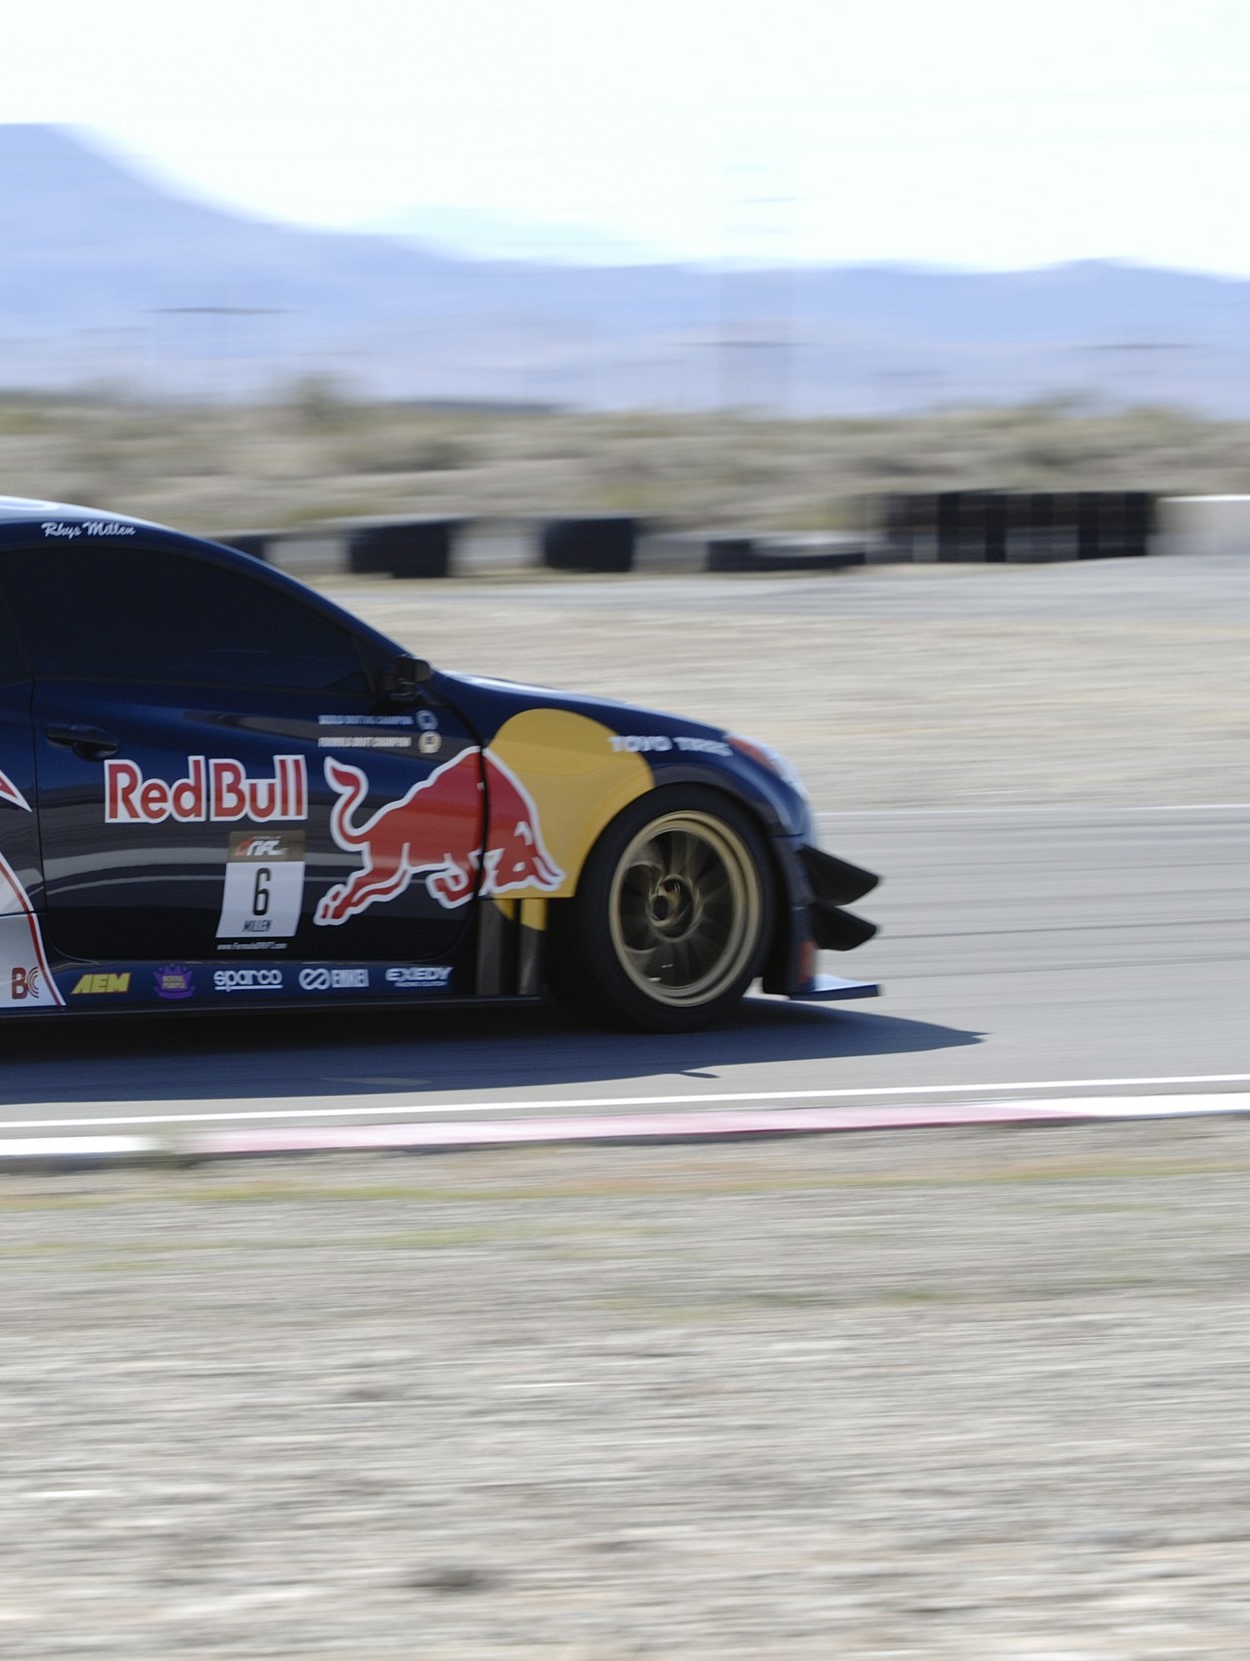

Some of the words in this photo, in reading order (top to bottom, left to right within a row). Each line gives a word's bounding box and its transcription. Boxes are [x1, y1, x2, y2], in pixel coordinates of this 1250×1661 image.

[41, 522, 82, 539] Rhys
[82, 521, 136, 536] Millen
[252, 867, 272, 916] 6
[70, 973, 131, 994] AEM
[213, 969, 283, 991] sparco
[385, 966, 454, 981] EXEDY
